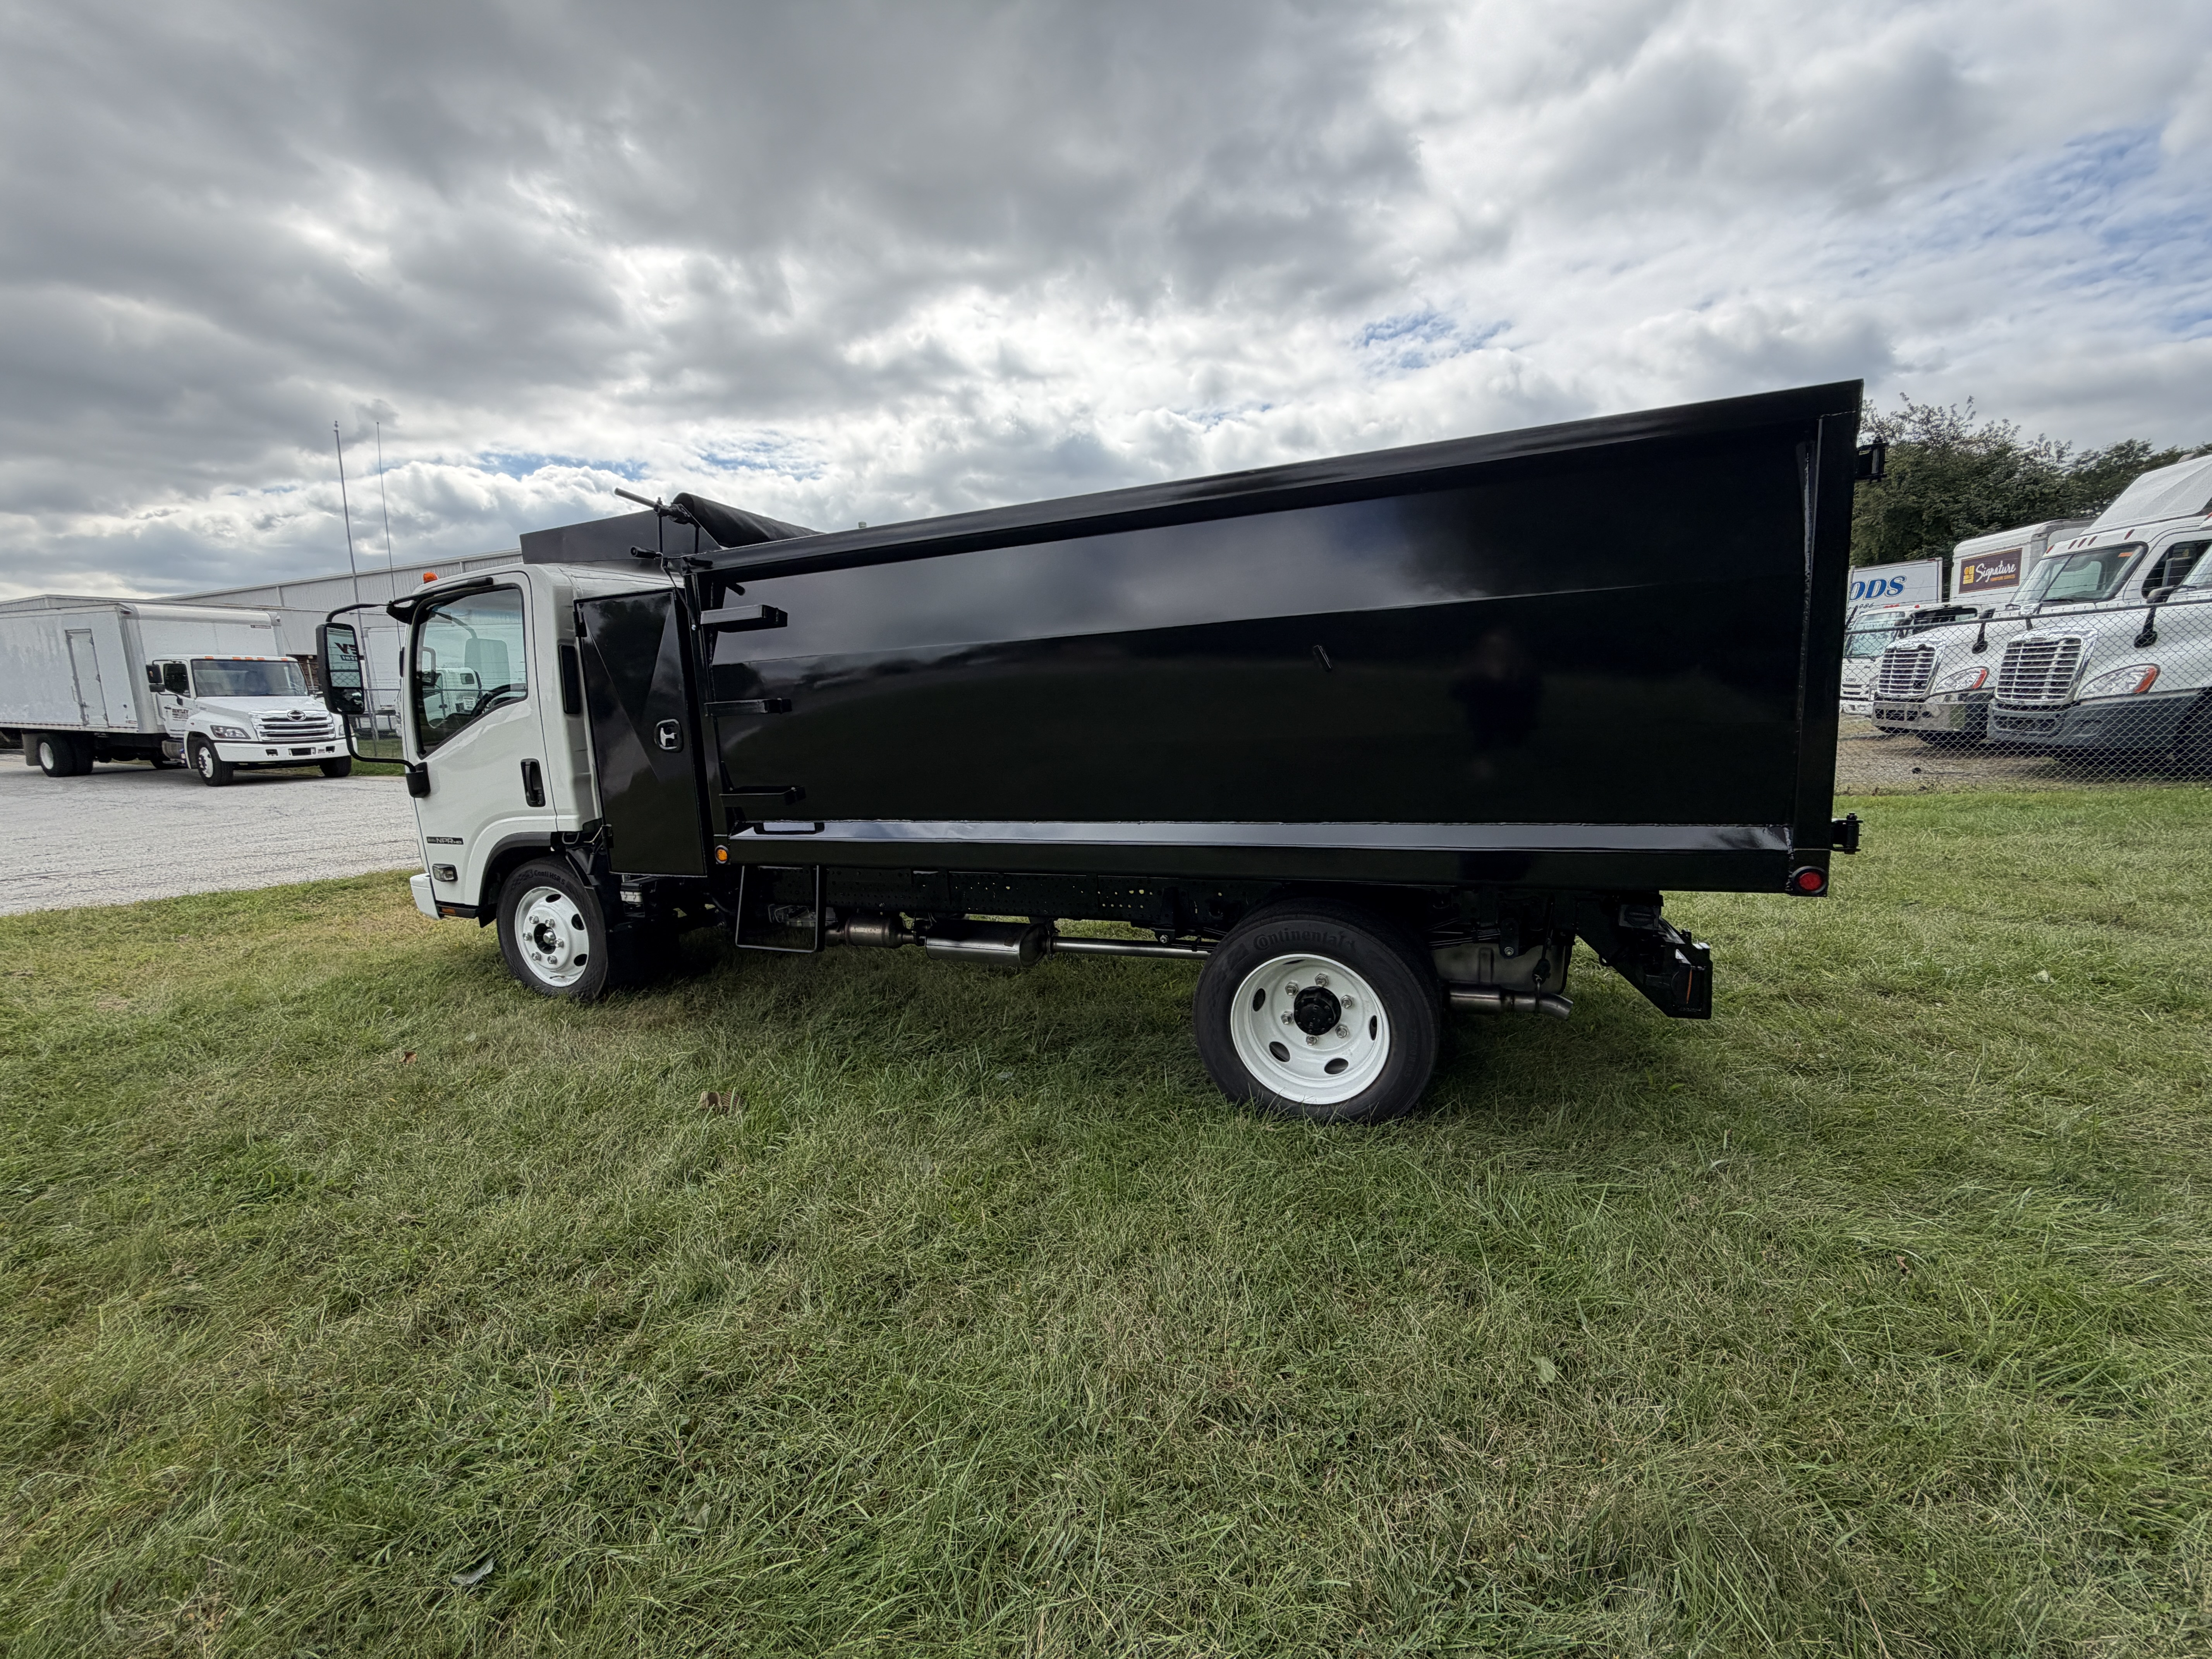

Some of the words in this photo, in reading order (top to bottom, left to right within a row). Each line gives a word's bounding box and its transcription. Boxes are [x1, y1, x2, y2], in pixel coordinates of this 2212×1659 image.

[1975, 560, 2016, 582] Signature
[1850, 575, 1906, 601] ODS
[1253, 928, 1347, 950] Continental
